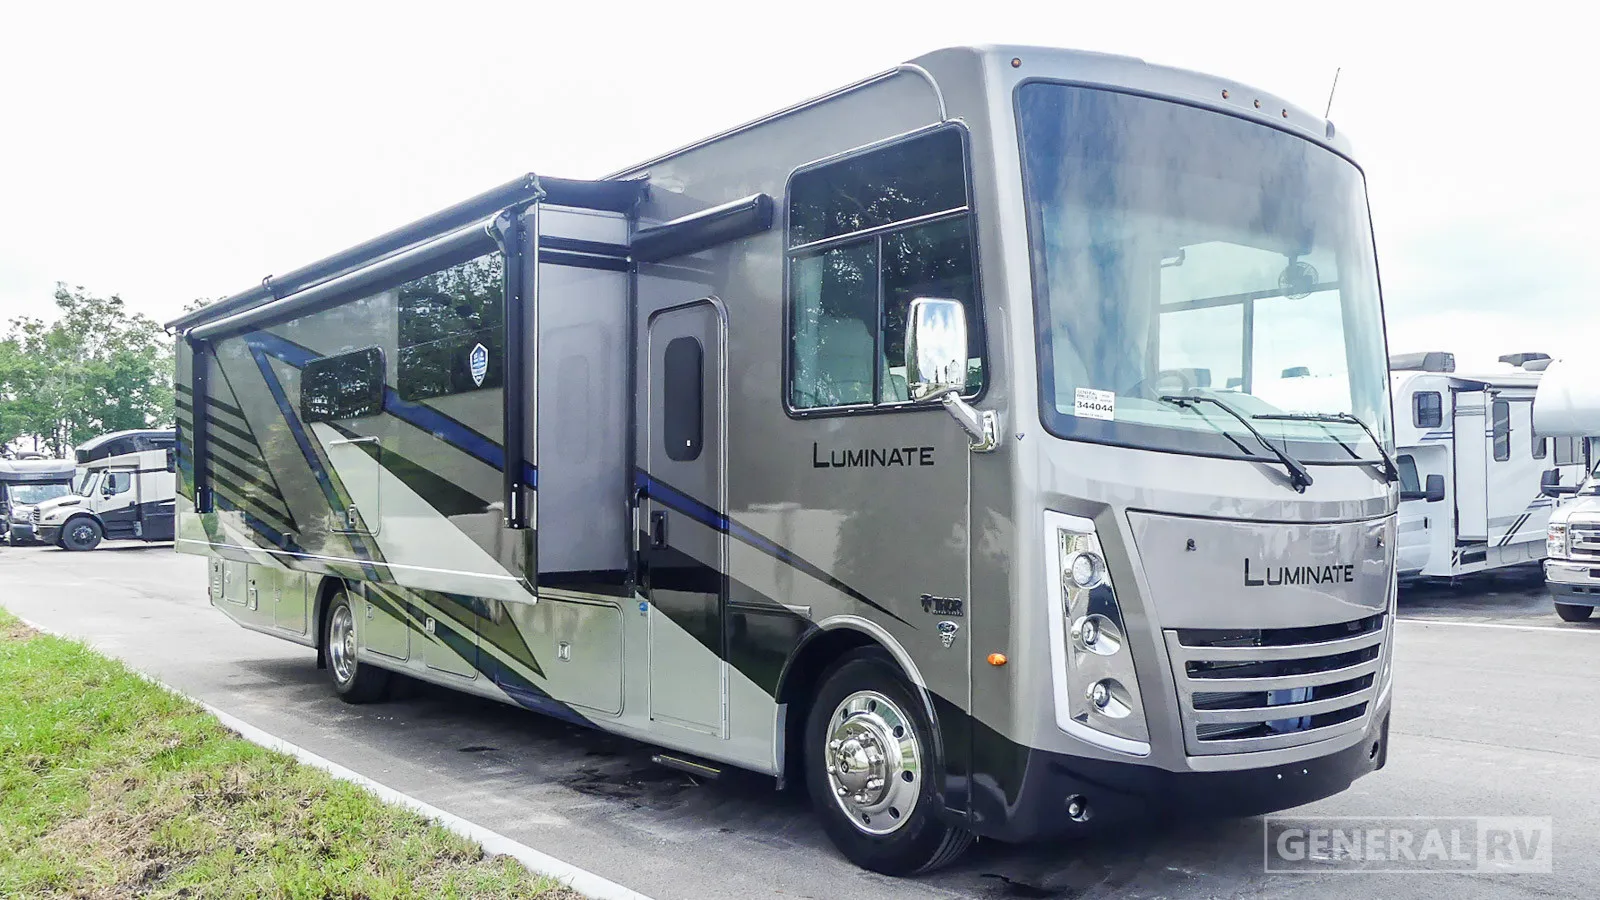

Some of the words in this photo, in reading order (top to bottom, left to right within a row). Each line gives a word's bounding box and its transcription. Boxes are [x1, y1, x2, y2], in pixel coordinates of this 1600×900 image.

[1077, 401, 1113, 412] 344044
[813, 442, 935, 468] LUMINATE
[1244, 558, 1354, 587] LUMINATE
